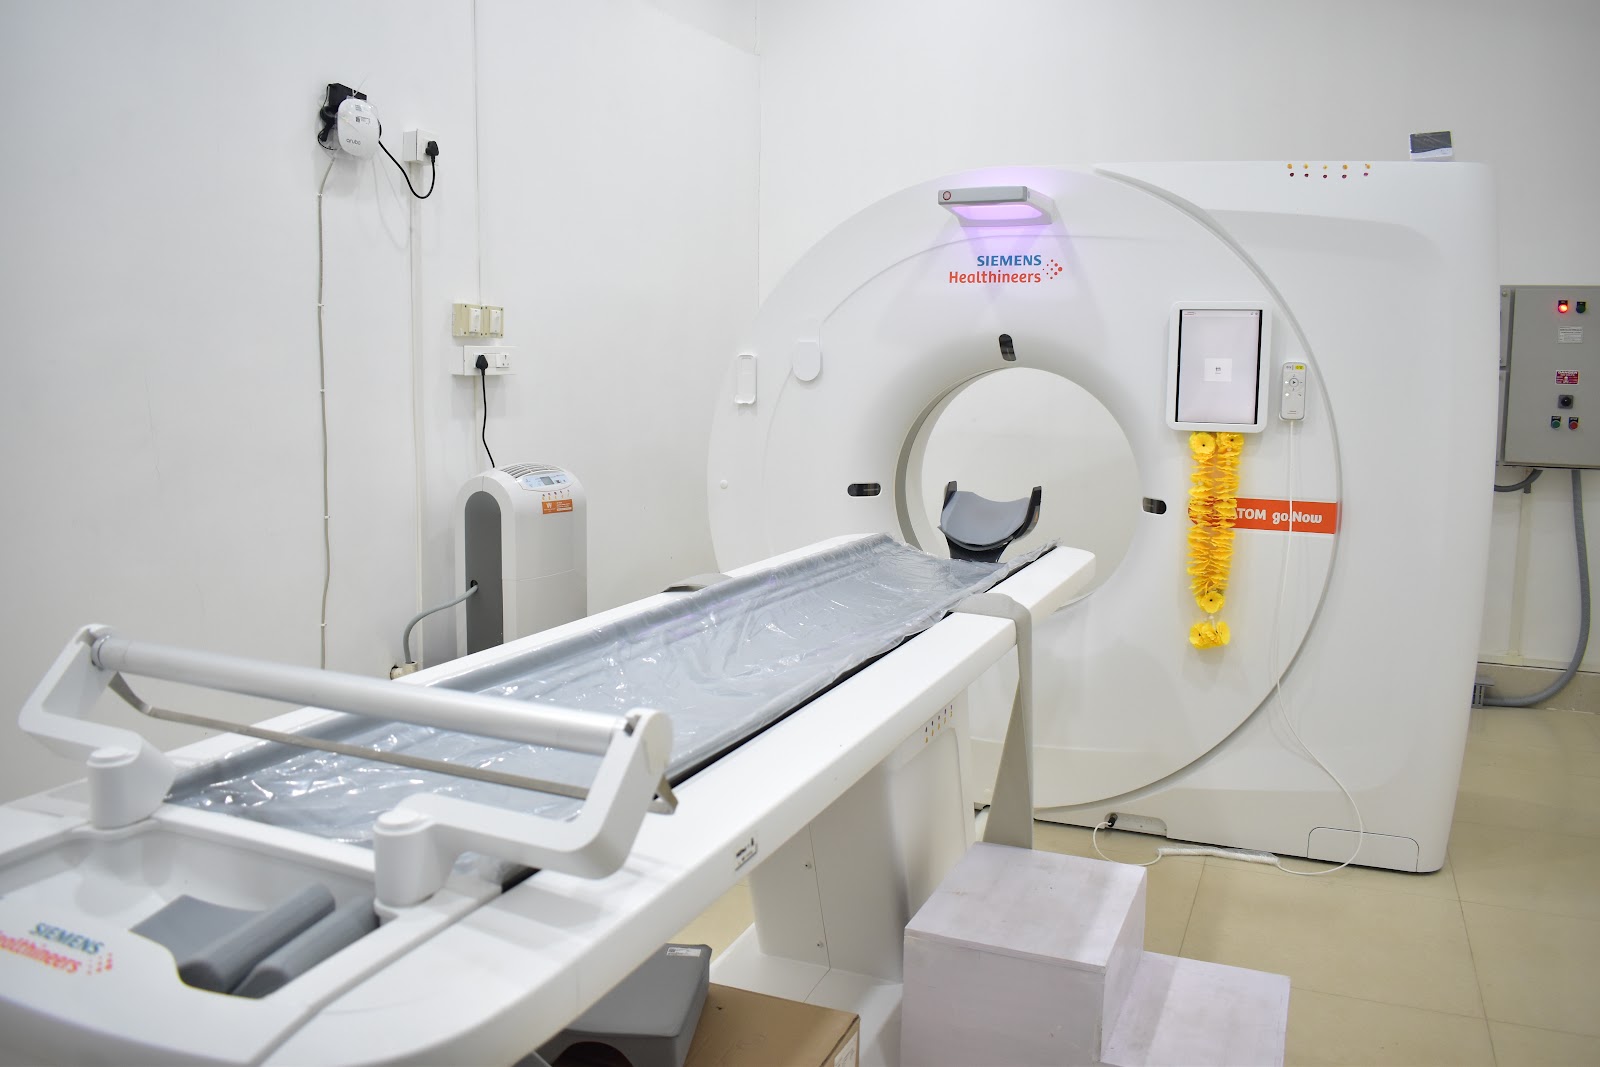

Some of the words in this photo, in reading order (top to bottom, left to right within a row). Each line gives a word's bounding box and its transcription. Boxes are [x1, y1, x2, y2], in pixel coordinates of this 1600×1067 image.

[977, 254, 1042, 267] SIEMENS
[949, 269, 1041, 284] Healthineers
[29, 922, 104, 955] SIEMENS
